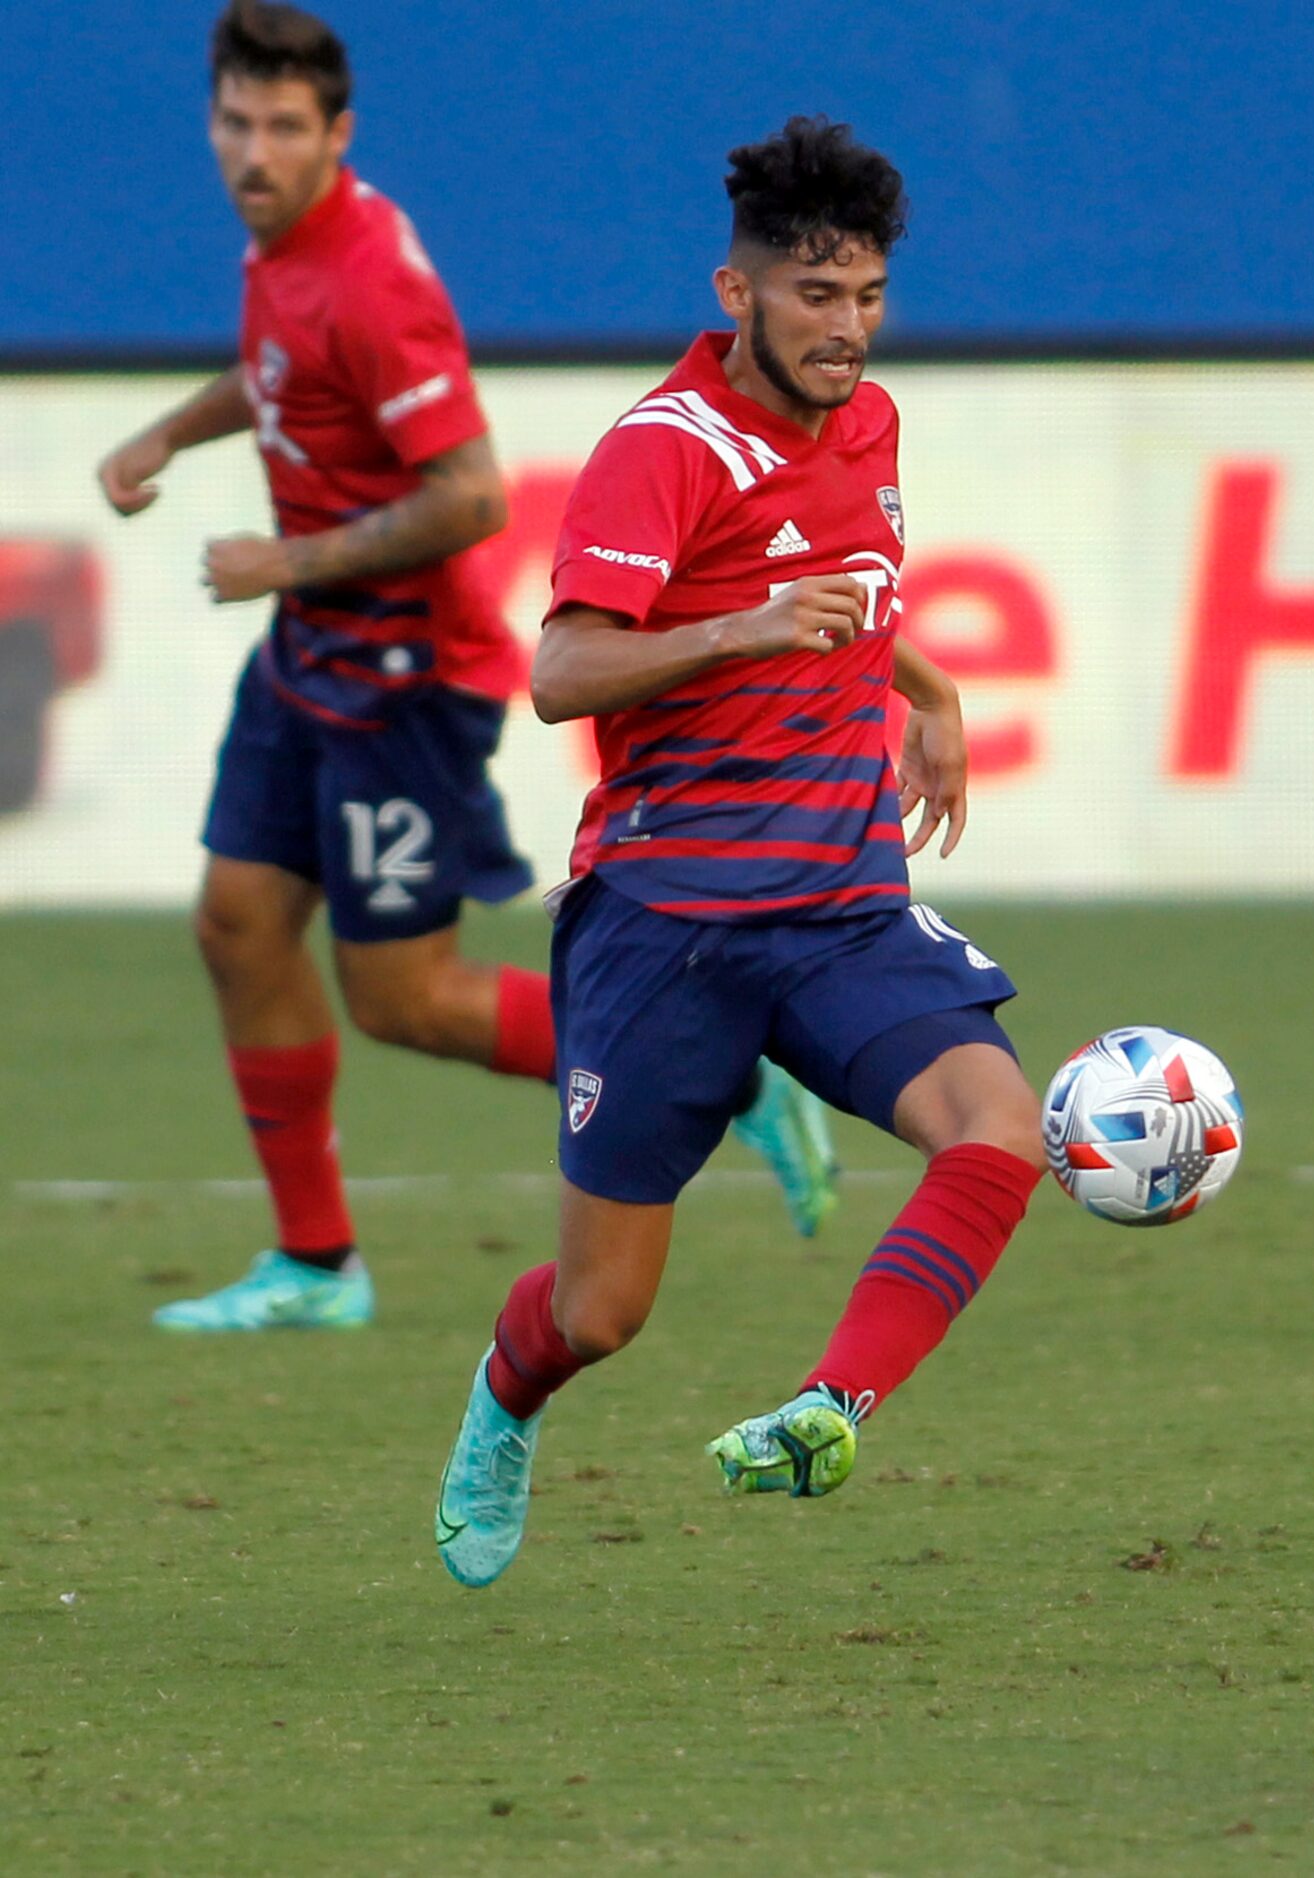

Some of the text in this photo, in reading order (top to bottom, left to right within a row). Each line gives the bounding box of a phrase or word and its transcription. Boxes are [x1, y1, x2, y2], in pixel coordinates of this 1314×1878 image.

[582, 545, 672, 586] ADVOCA
[765, 538, 812, 558] adidas
[340, 797, 435, 881] 12
